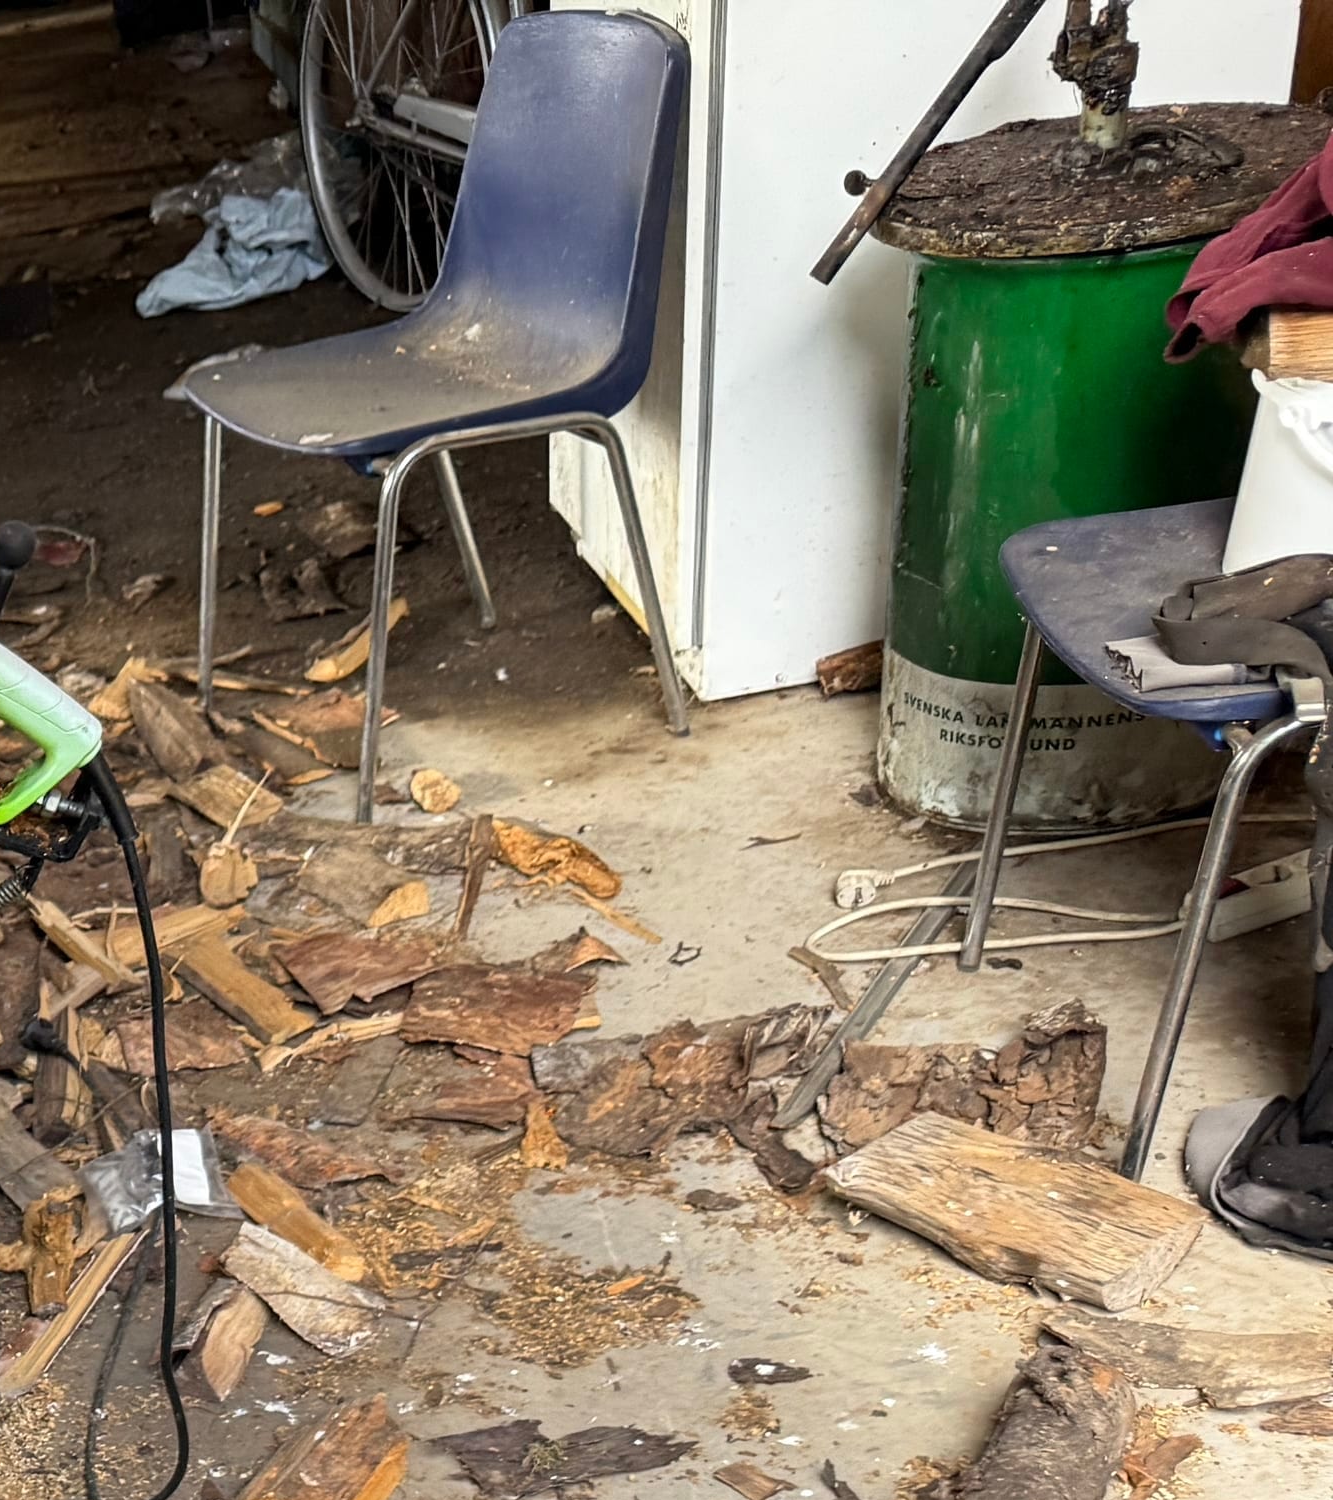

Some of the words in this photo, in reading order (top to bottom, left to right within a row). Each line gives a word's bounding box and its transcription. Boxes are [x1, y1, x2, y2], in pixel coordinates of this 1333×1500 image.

[904, 692, 964, 723] SVENSKA
[976, 711, 1146, 729] LANMÄNNENS
[939, 729, 1076, 751] RIKSFÖUND
